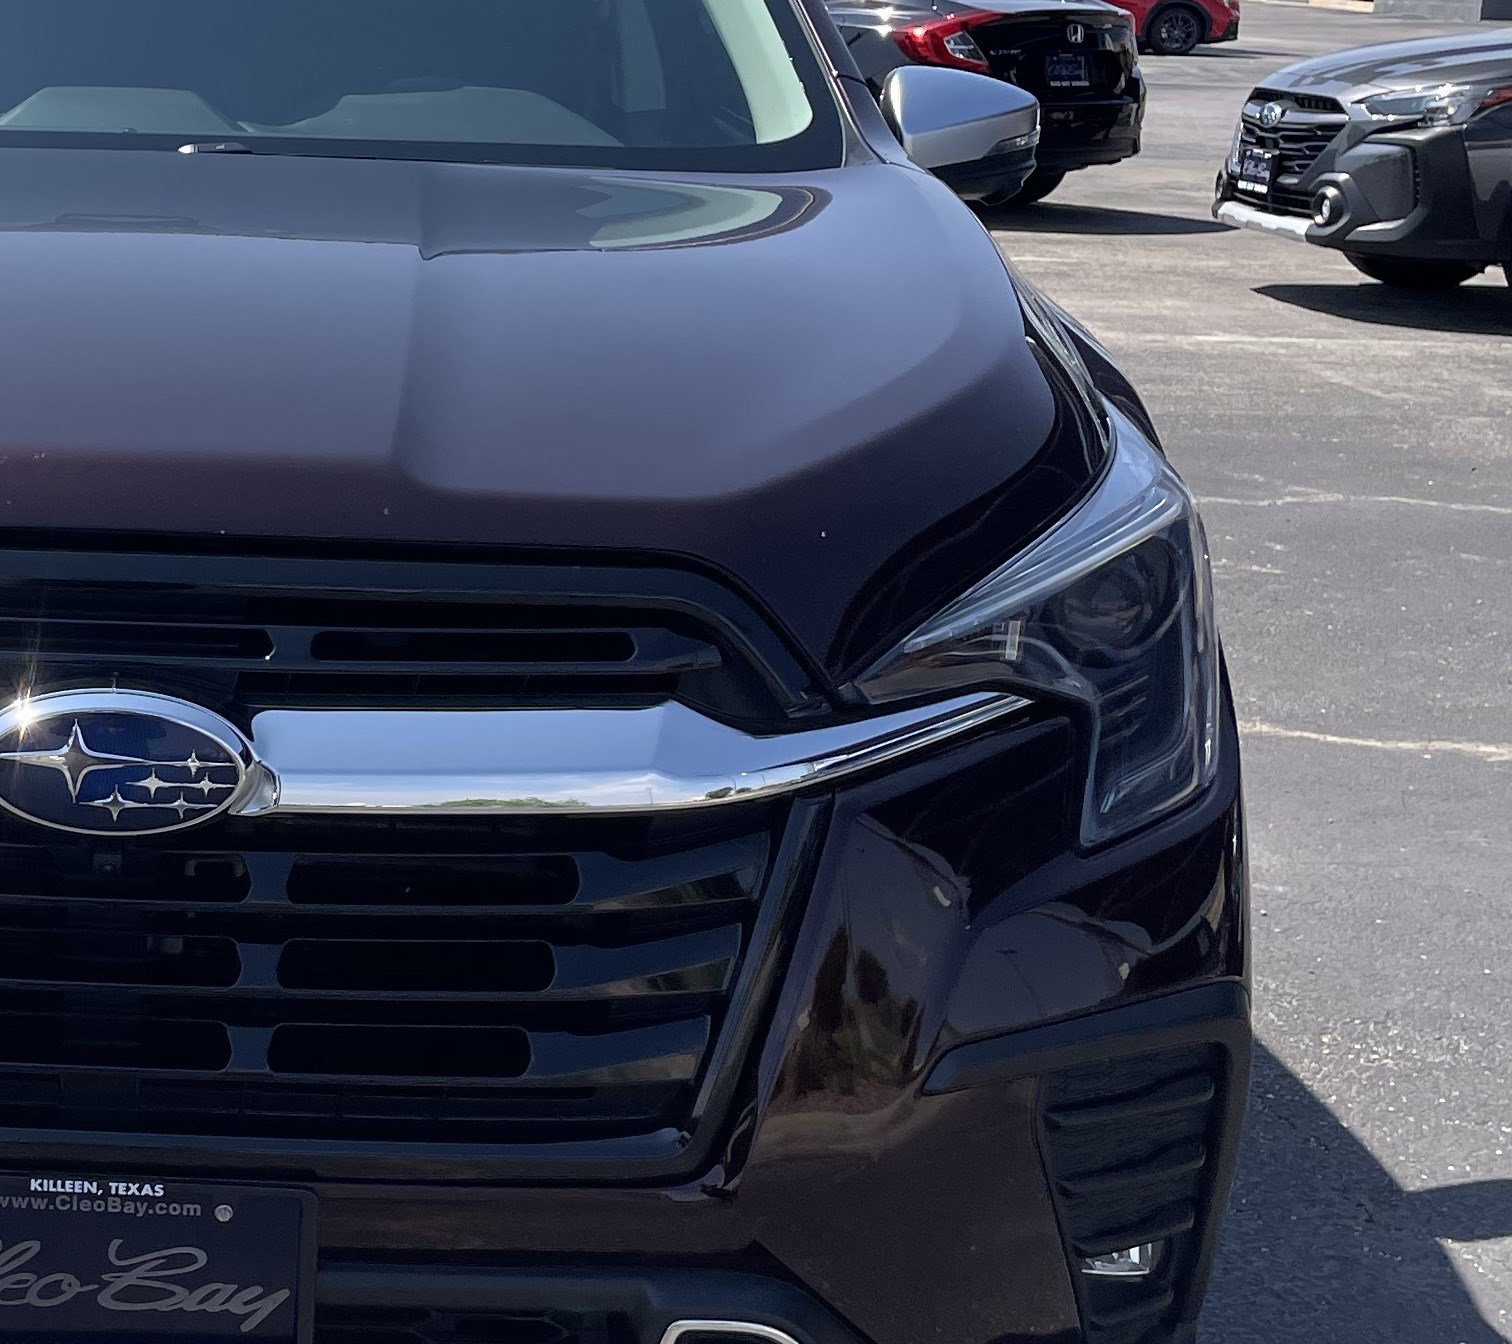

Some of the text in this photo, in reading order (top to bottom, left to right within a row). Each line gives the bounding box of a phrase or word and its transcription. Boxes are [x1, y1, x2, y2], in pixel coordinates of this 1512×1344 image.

[30, 1178, 166, 1197] KILLEEN, TEXAS
[96, 1238, 292, 1333] Bay
